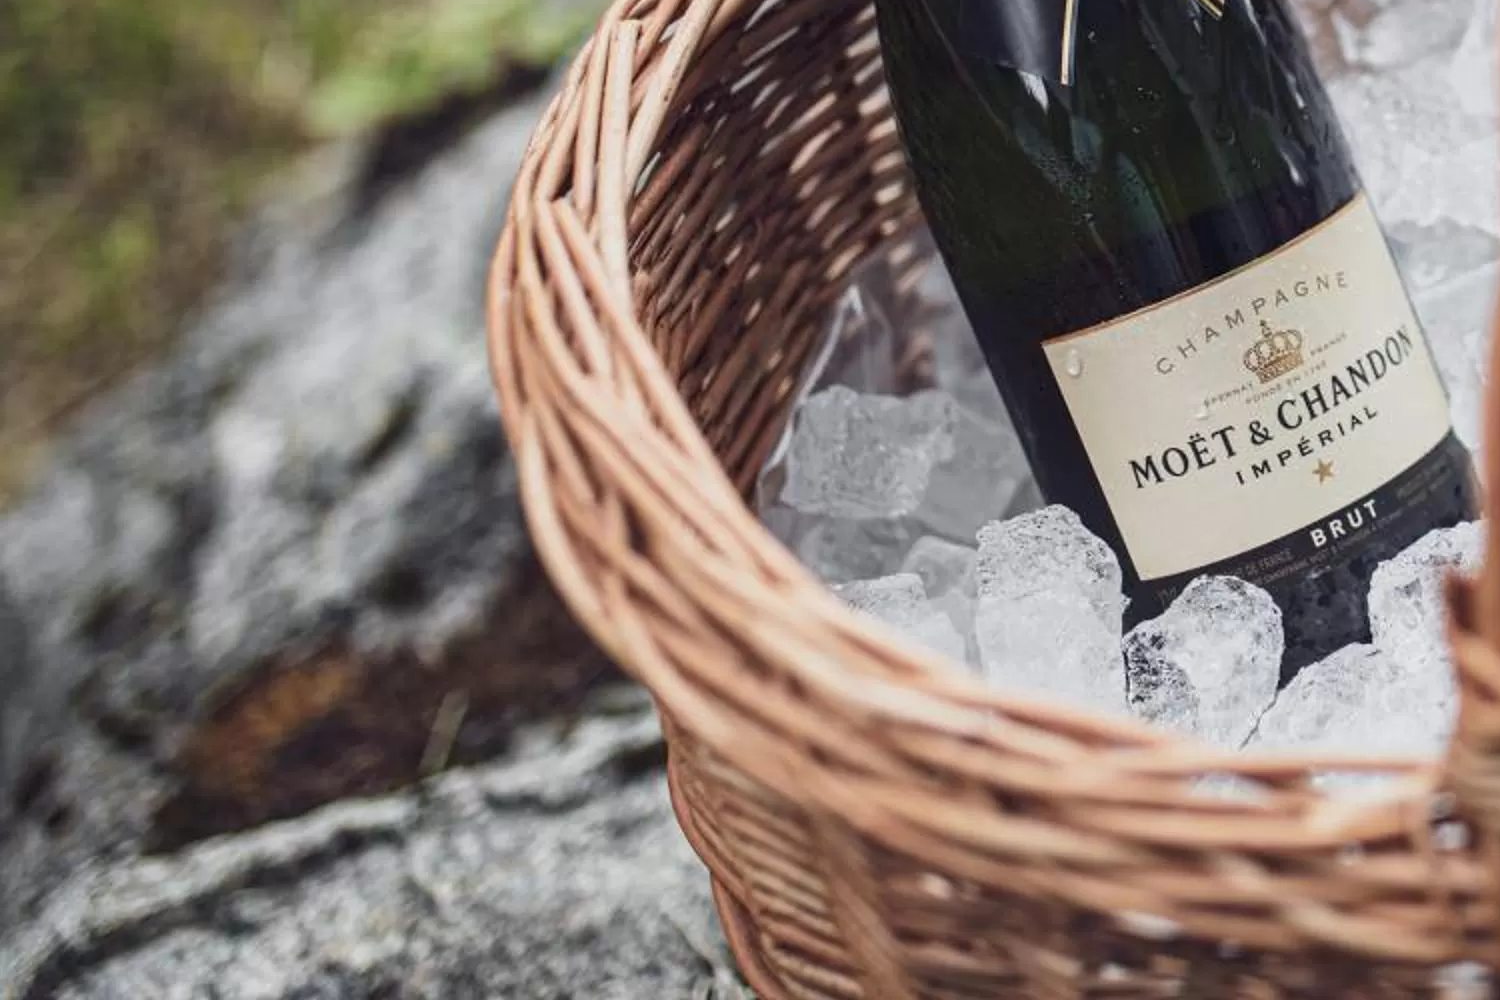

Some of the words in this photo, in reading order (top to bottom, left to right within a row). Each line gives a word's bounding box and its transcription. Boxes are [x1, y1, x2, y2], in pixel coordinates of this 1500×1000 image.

[1155, 270, 1349, 376] CHAMPAGNE
[1128, 424, 1240, 489] MOËT
[1249, 418, 1273, 447] &
[1276, 324, 1415, 430] CHANDON
[1235, 405, 1379, 486] IMPÉRIAL
[1309, 499, 1378, 548] BRUT
